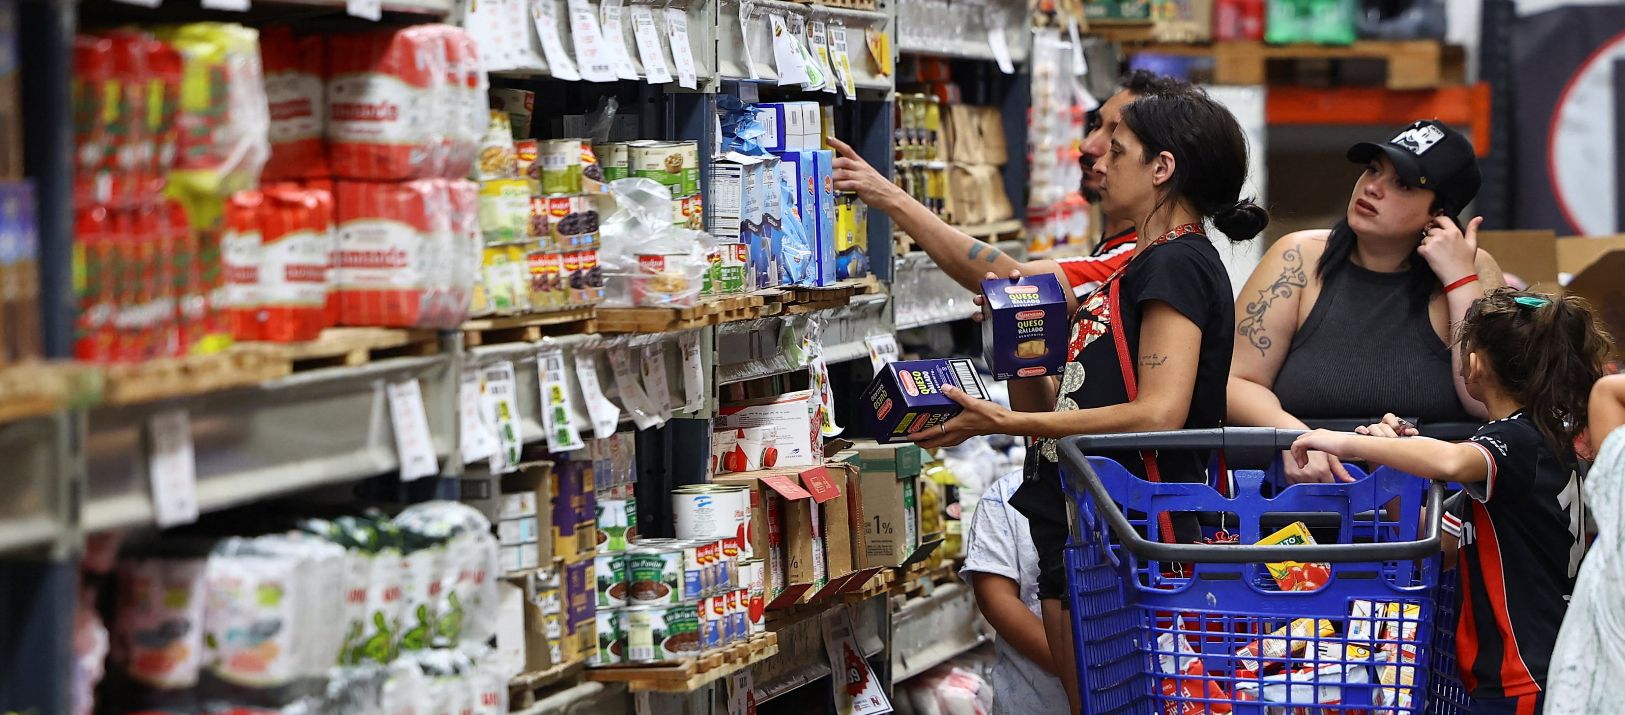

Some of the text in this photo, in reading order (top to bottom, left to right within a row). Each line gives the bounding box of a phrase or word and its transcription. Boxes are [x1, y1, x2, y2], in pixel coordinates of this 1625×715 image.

[1009, 293, 1039, 301] QUESO
[1017, 319, 1044, 329] QUESO
[912, 370, 930, 395] QUESO
